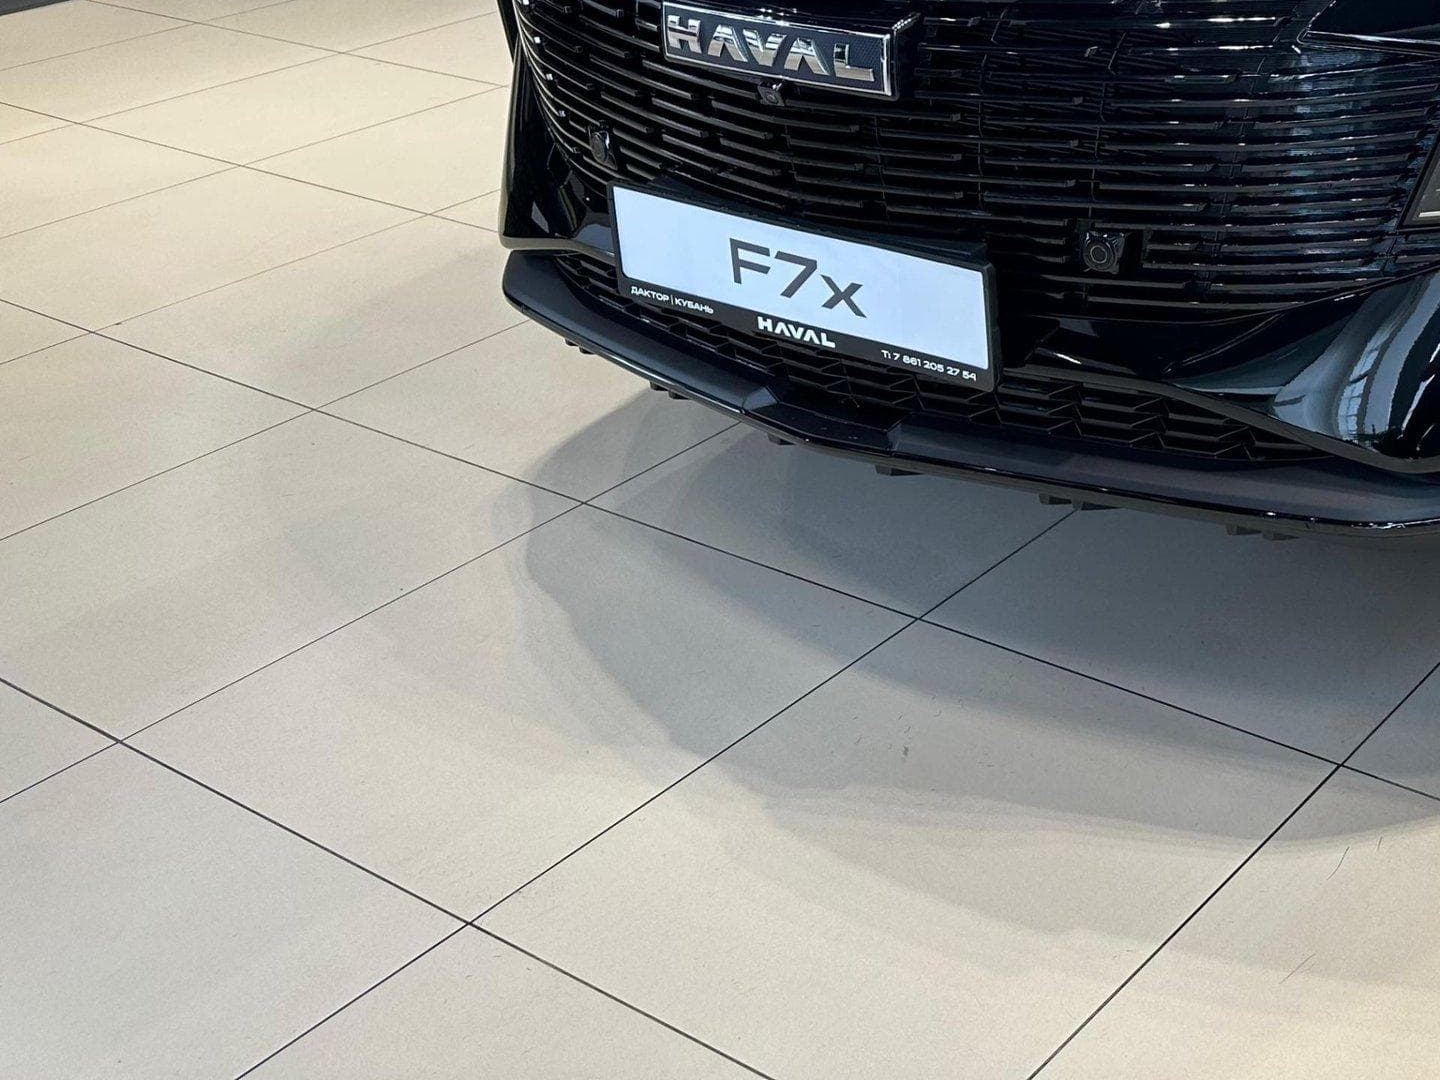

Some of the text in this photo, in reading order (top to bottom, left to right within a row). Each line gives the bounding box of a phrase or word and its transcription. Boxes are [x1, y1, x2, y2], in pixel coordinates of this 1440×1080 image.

[667, 14, 875, 82] HAVAL
[630, 285, 714, 315] ДАКТОР КУБАНЬ
[757, 316, 836, 348] HAVAL
[923, 360, 944, 372] 205
[946, 366, 960, 376] 27
